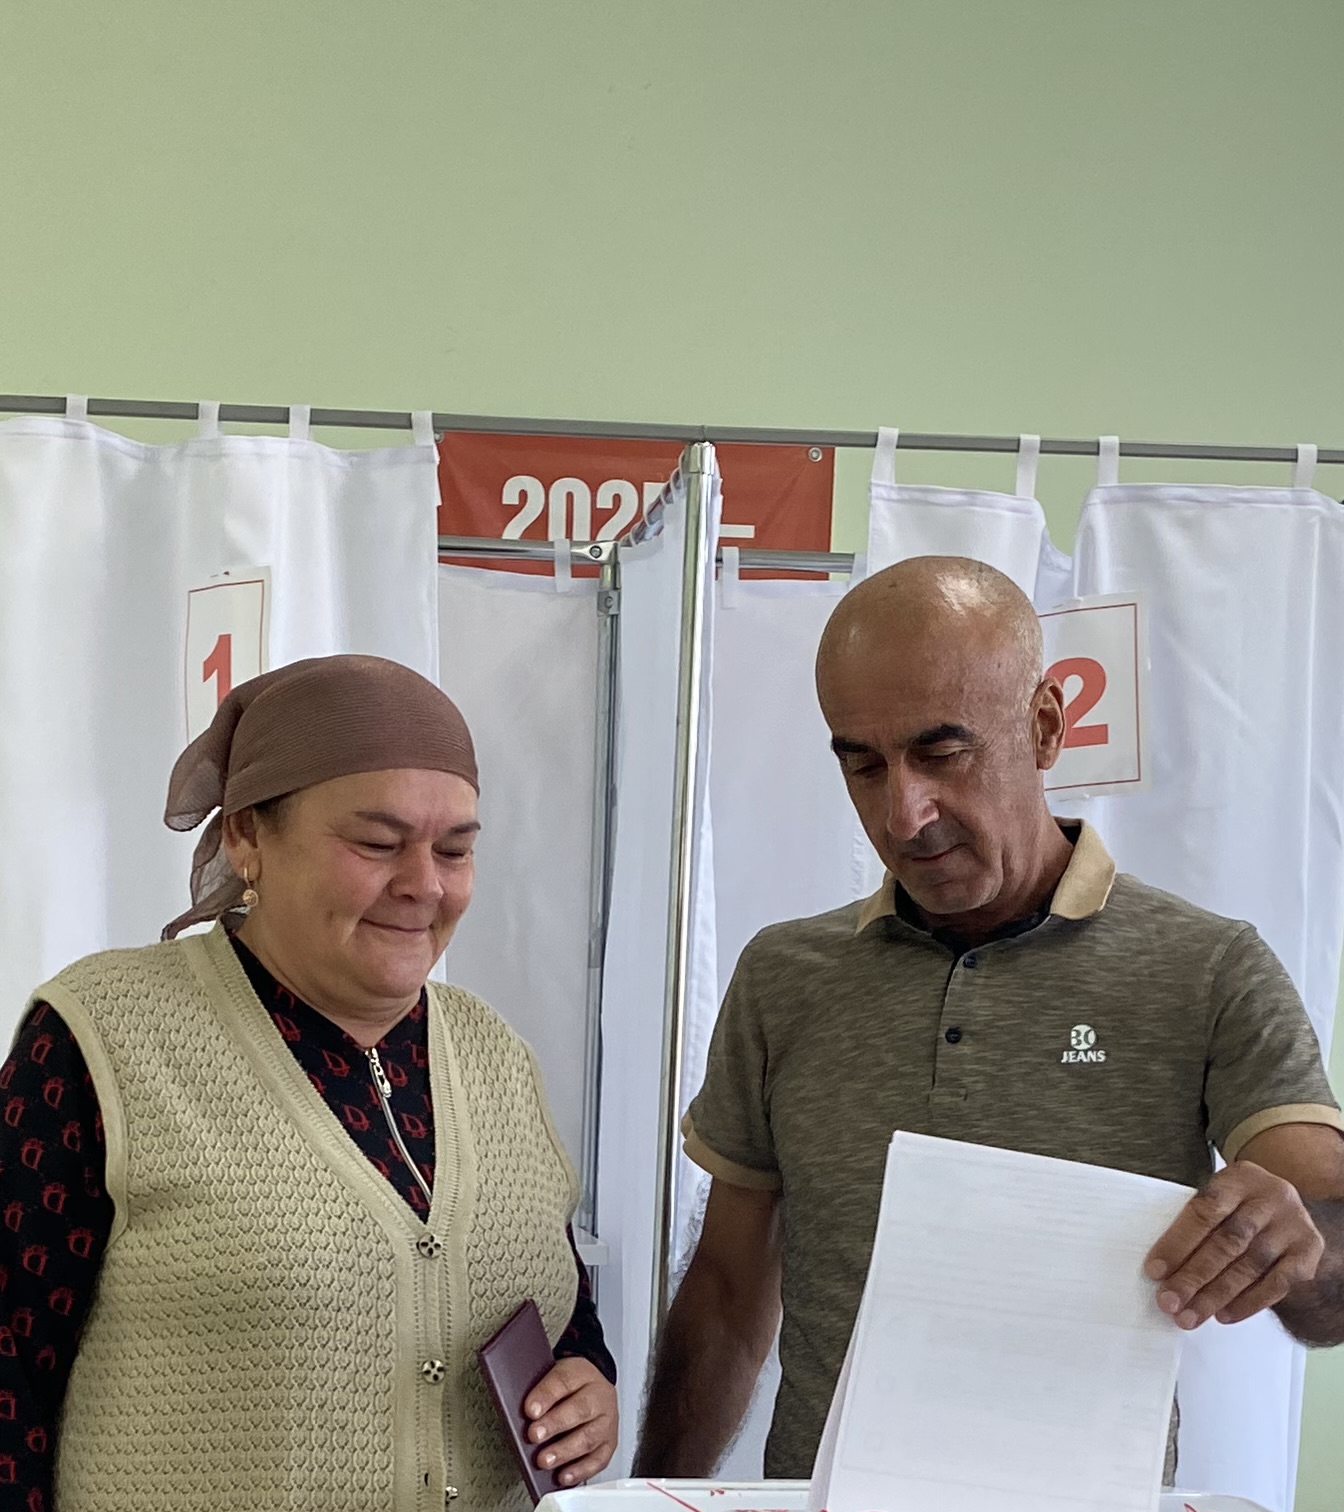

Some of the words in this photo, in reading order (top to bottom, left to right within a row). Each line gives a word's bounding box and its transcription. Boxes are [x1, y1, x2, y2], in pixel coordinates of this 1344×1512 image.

[501, 475, 669, 541] 202
[203, 633, 232, 706] 1
[1044, 657, 1109, 749] 2
[1061, 1050, 1106, 1063] JEANS
